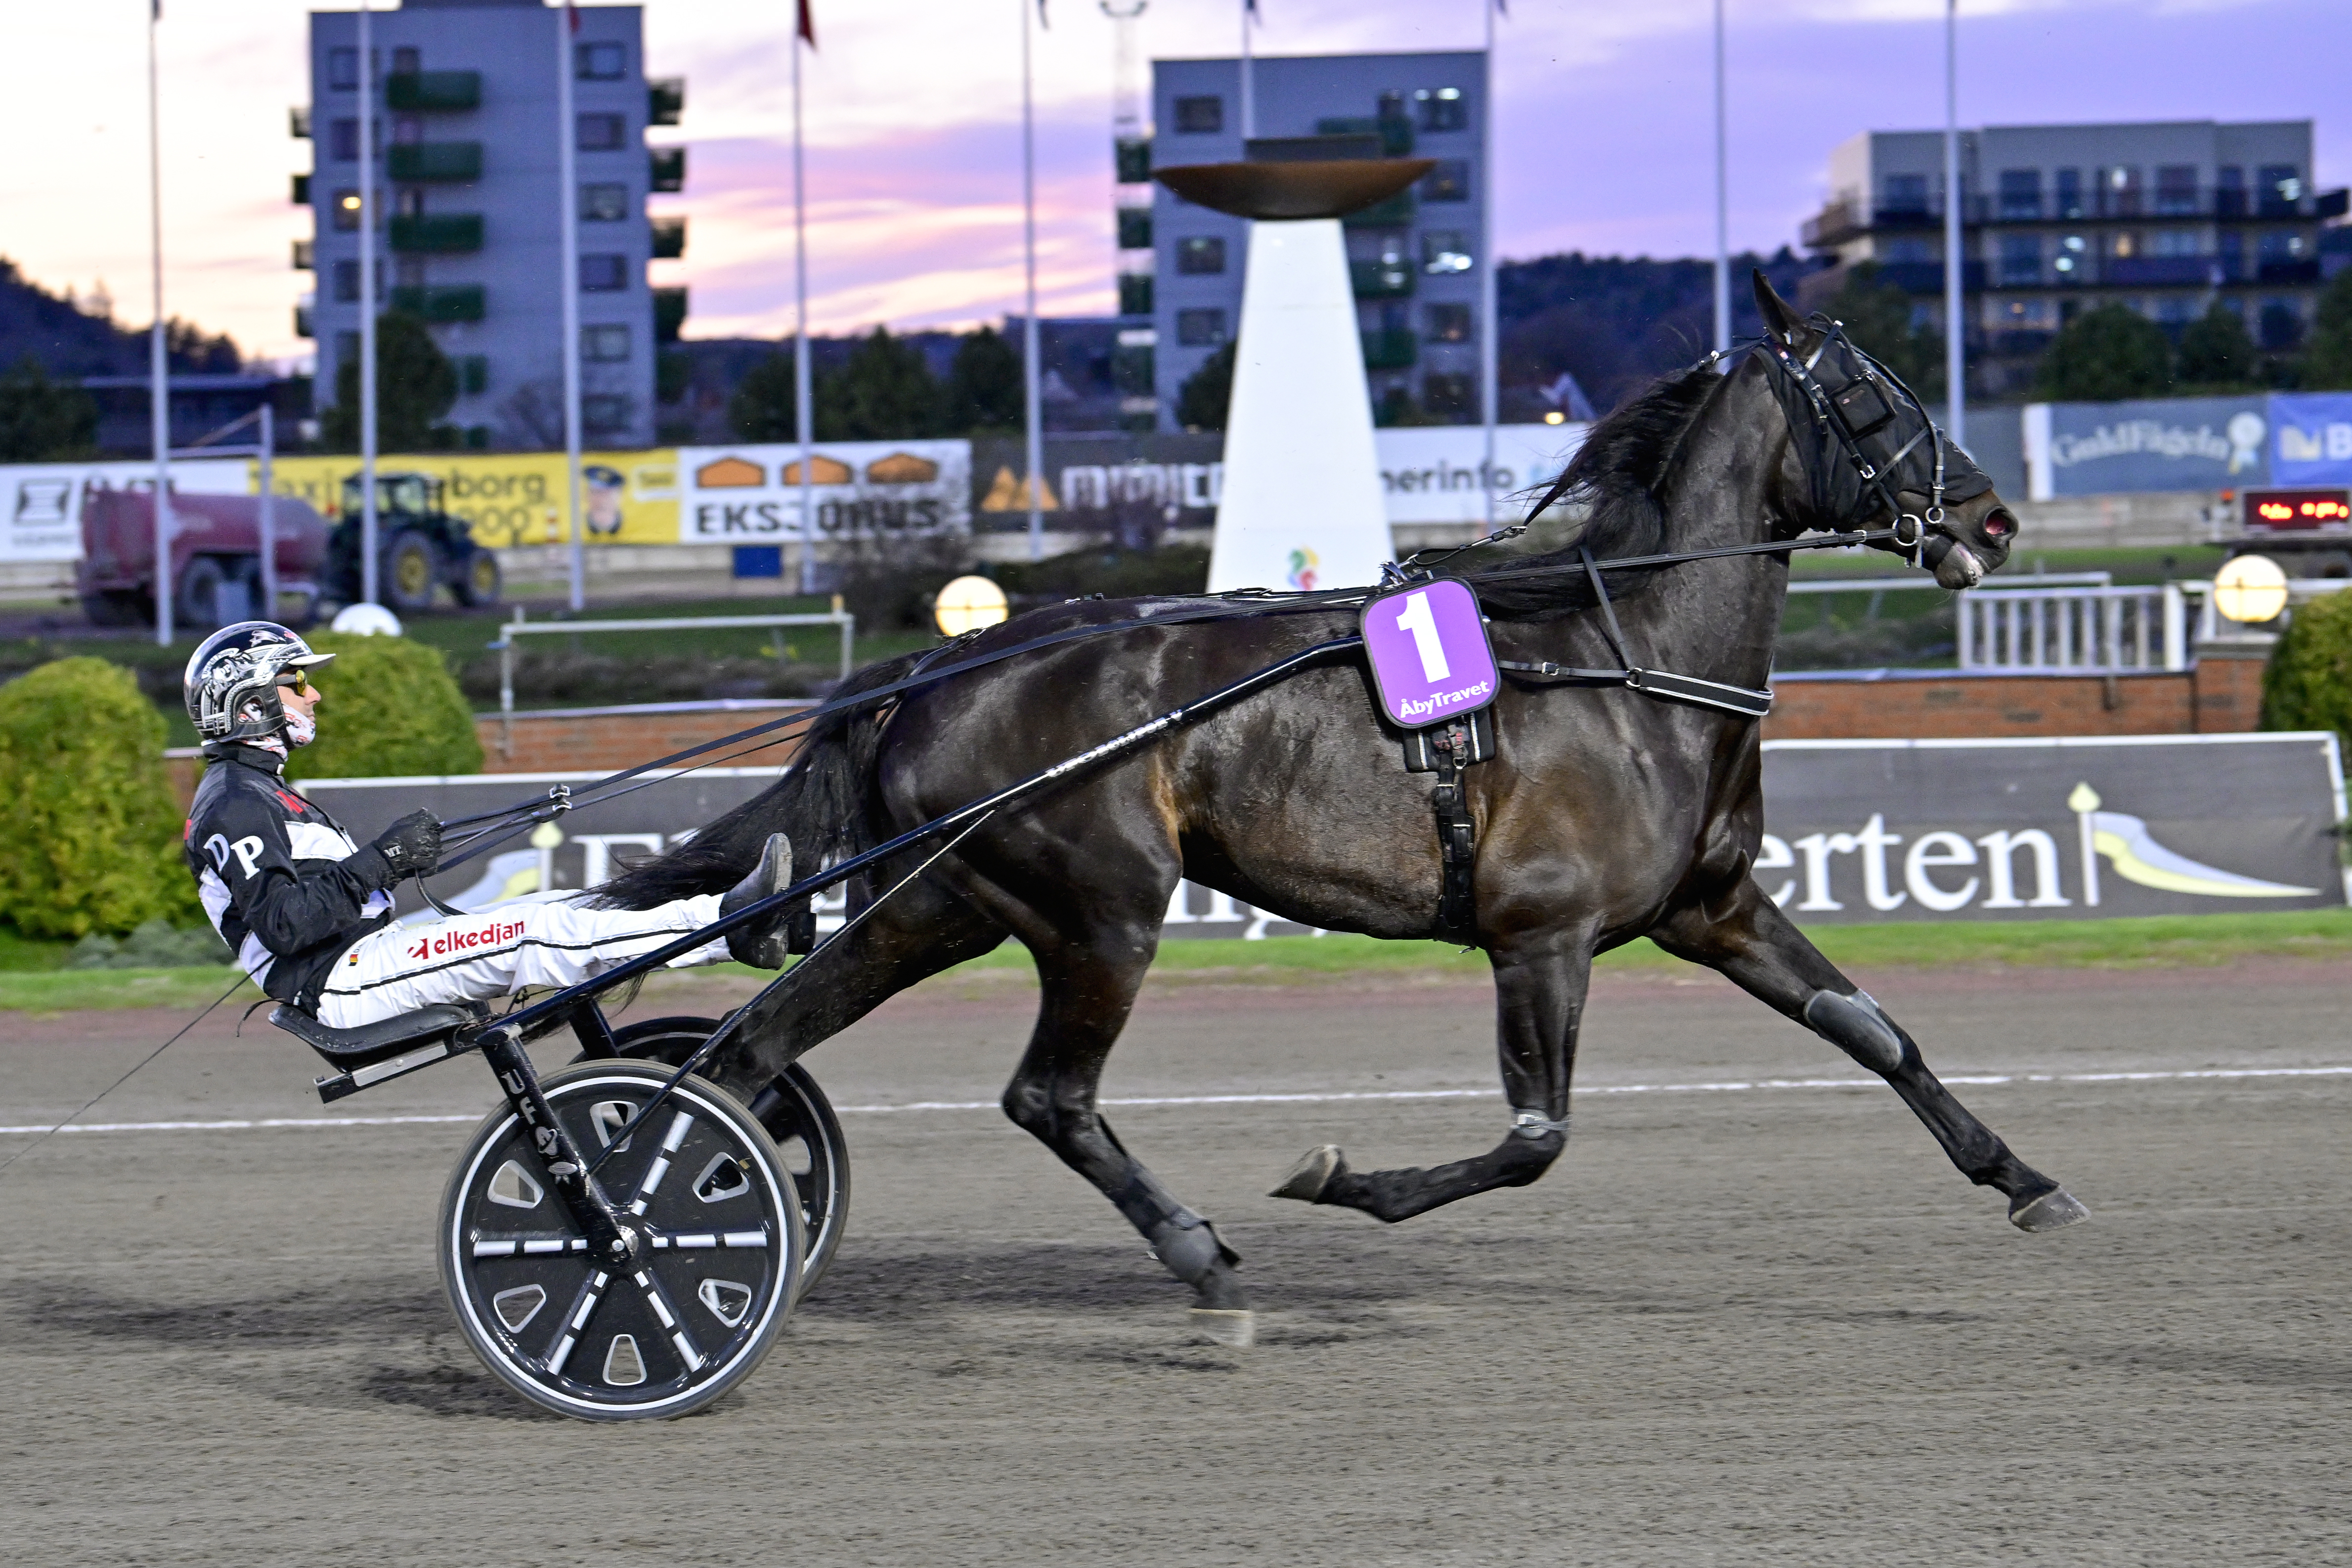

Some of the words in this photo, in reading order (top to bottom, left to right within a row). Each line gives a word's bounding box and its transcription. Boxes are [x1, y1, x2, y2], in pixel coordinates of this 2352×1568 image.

[451, 468, 546, 504] borg
[1395, 591, 1451, 683] 1
[1400, 680, 1490, 718] ÅbyTravet
[1752, 812, 2073, 912] erten
[434, 920, 525, 955] elkedjan
